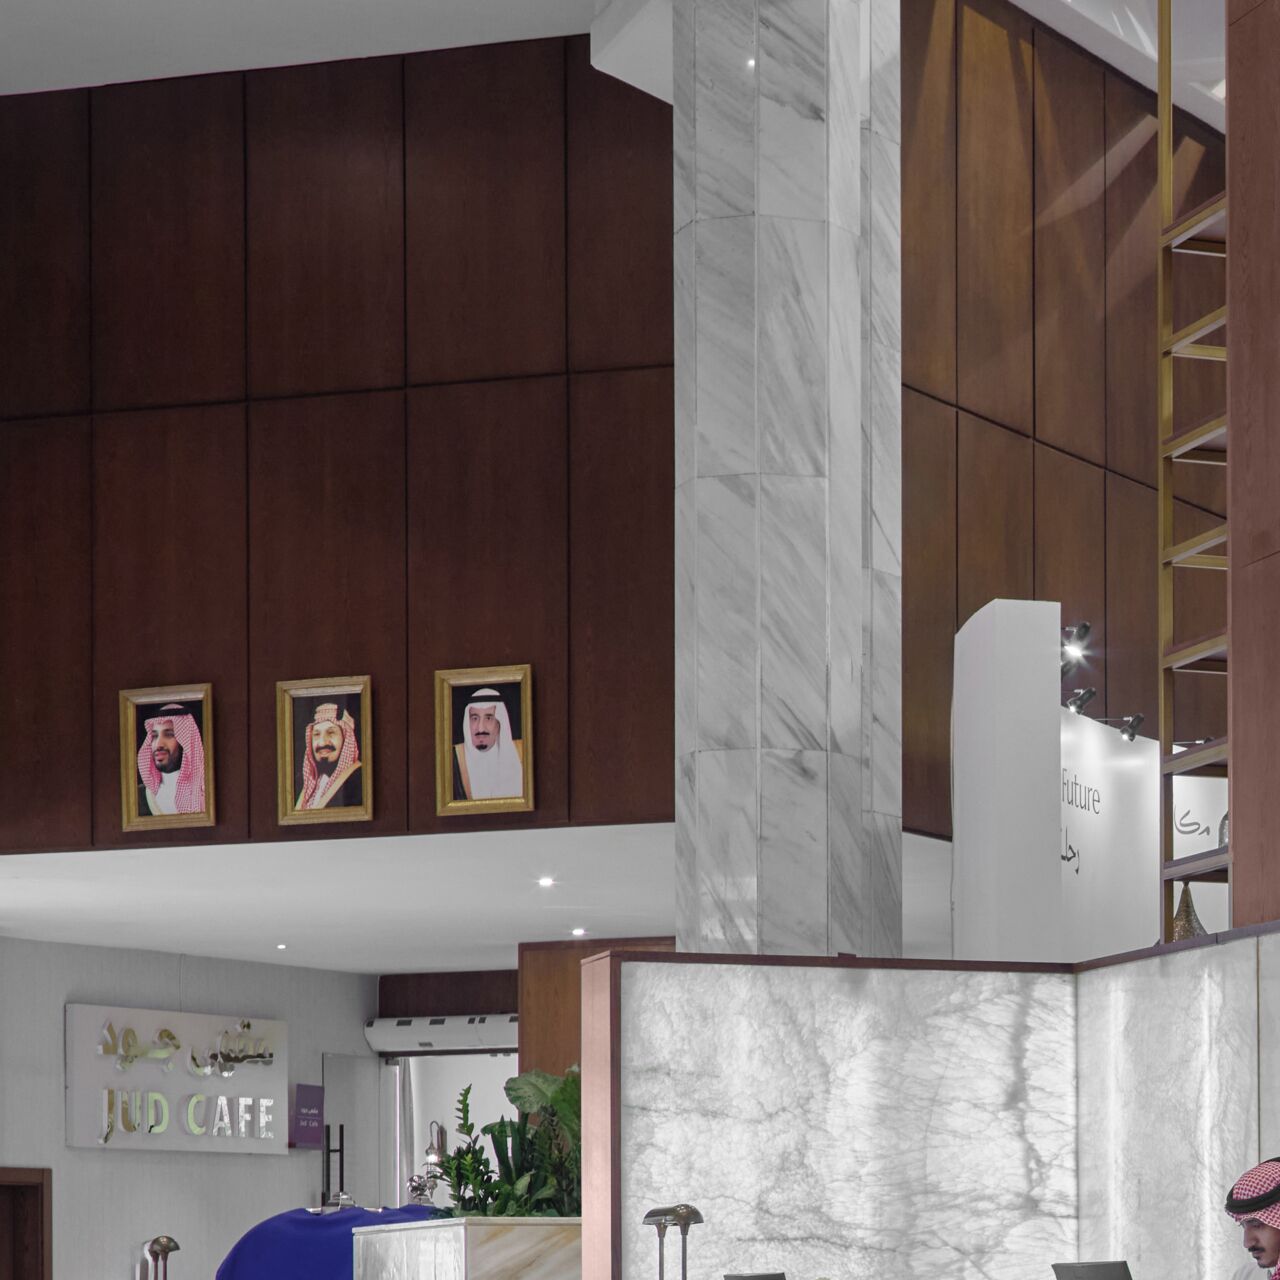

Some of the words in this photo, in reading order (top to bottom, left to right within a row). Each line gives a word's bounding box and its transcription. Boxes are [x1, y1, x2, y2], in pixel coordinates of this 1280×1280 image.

[1061, 768, 1101, 814] Future
[99, 1087, 170, 1144] JUD
[185, 1092, 274, 1139] CAFE
